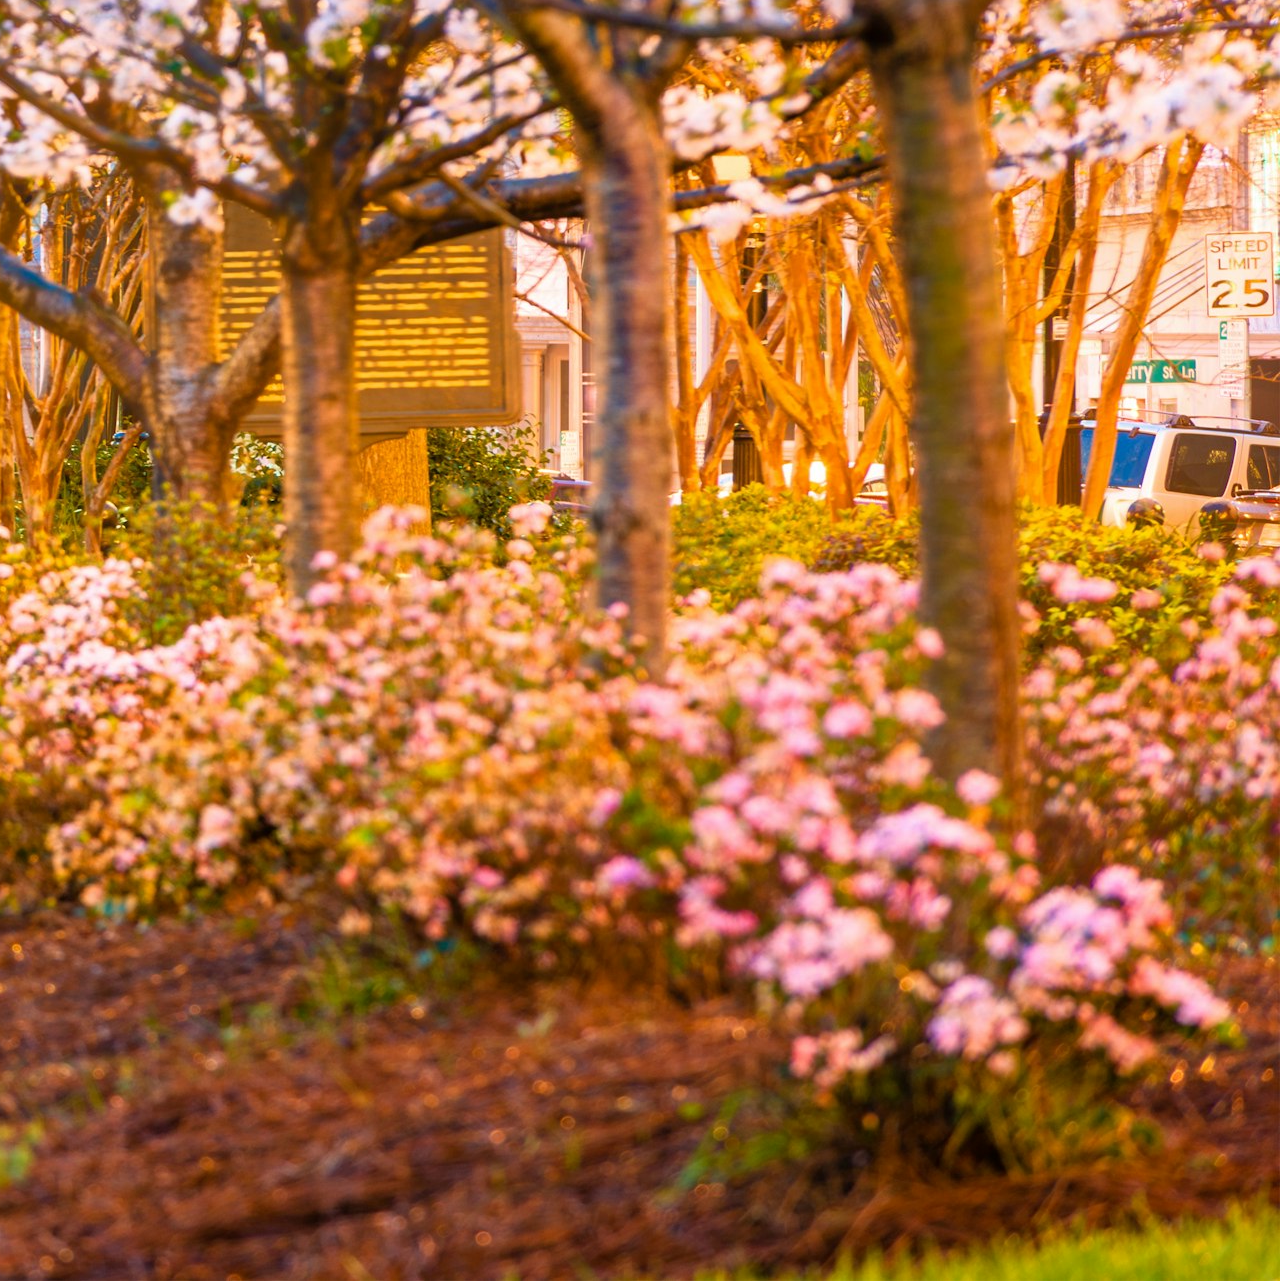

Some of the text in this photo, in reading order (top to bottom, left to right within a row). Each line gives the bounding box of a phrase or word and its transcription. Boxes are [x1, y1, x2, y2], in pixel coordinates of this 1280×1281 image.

[1210, 240, 1268, 253] SPEED
[1218, 257, 1260, 270] LIMIT
[1211, 279, 1269, 308] 25
[1162, 366, 1173, 379] St
[1182, 365, 1194, 379] Ln
